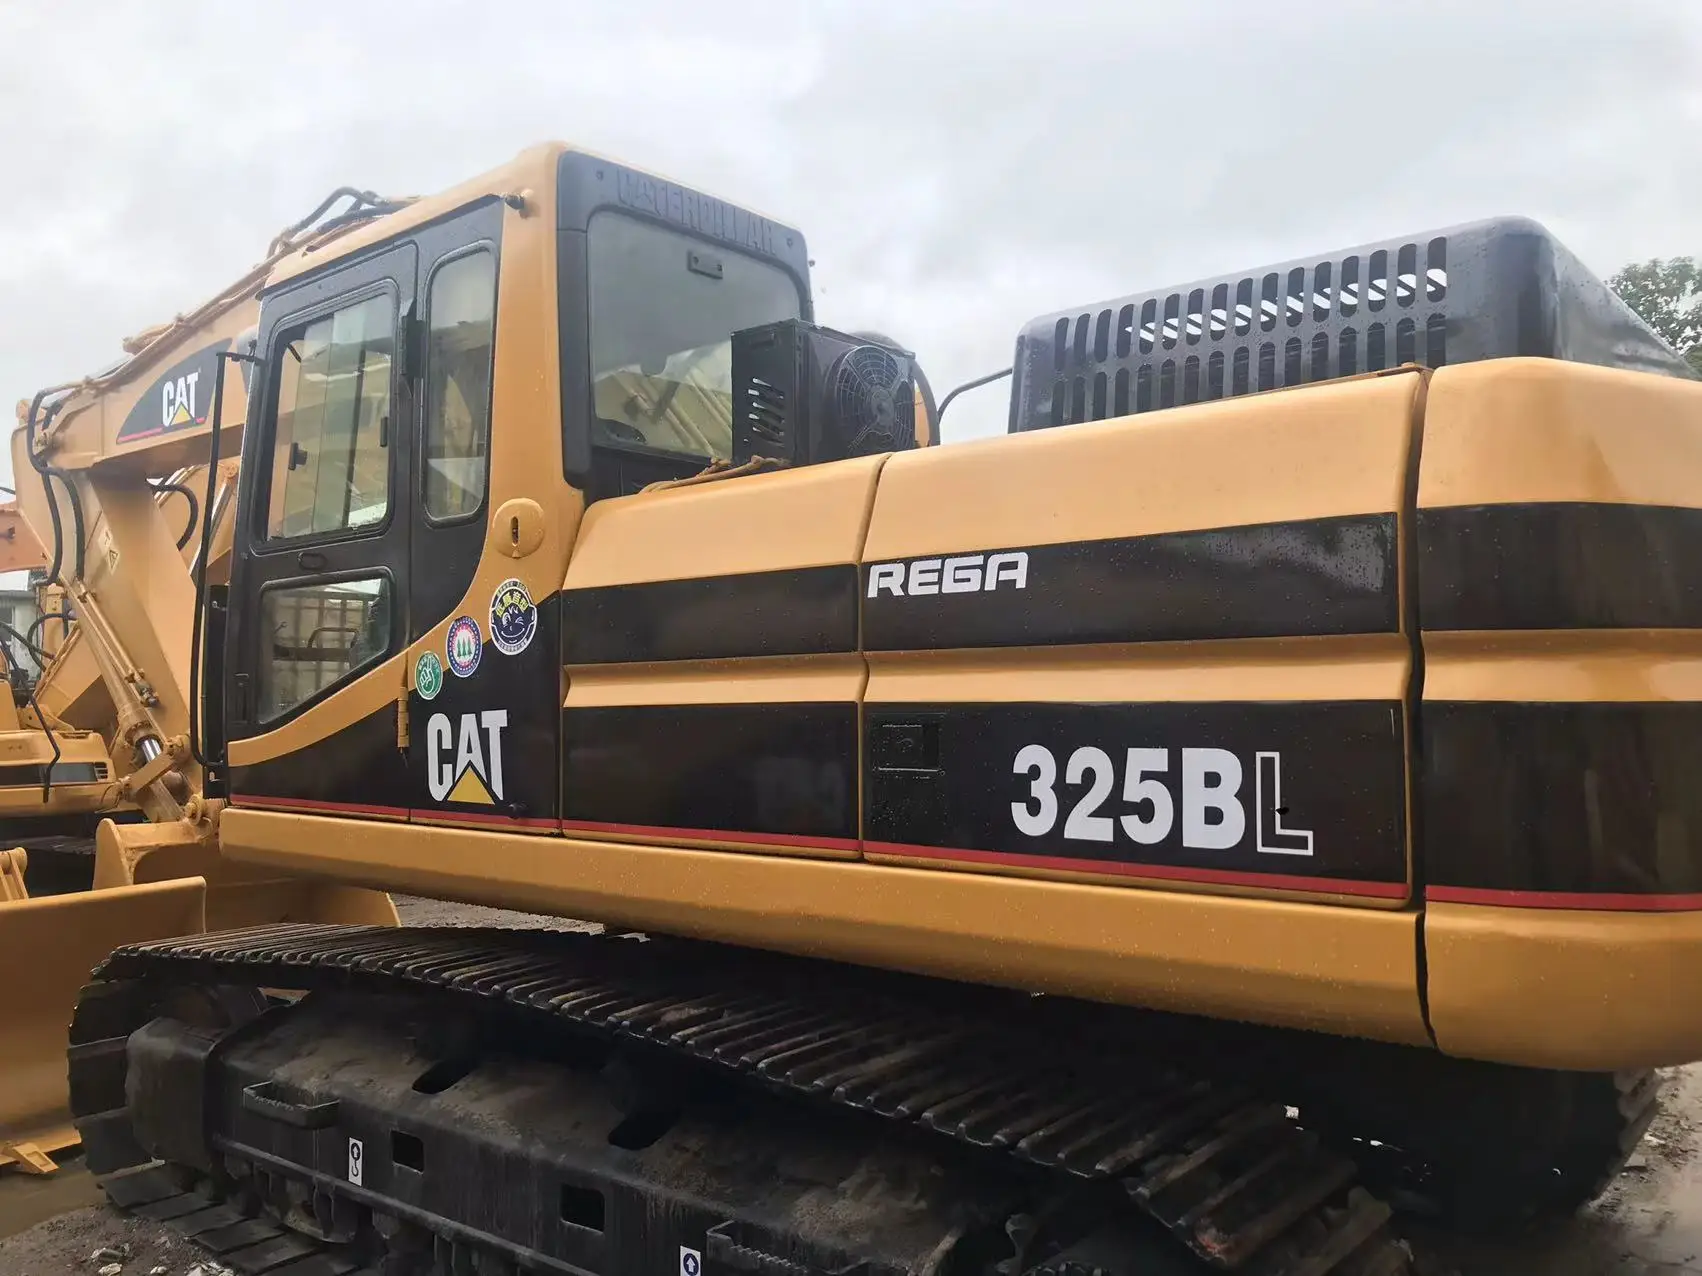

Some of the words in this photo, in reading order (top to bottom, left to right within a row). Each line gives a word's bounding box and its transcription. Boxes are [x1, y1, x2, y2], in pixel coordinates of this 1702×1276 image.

[162, 371, 198, 427] CAT
[867, 552, 1028, 598] REGA
[427, 709, 508, 803] CAT
